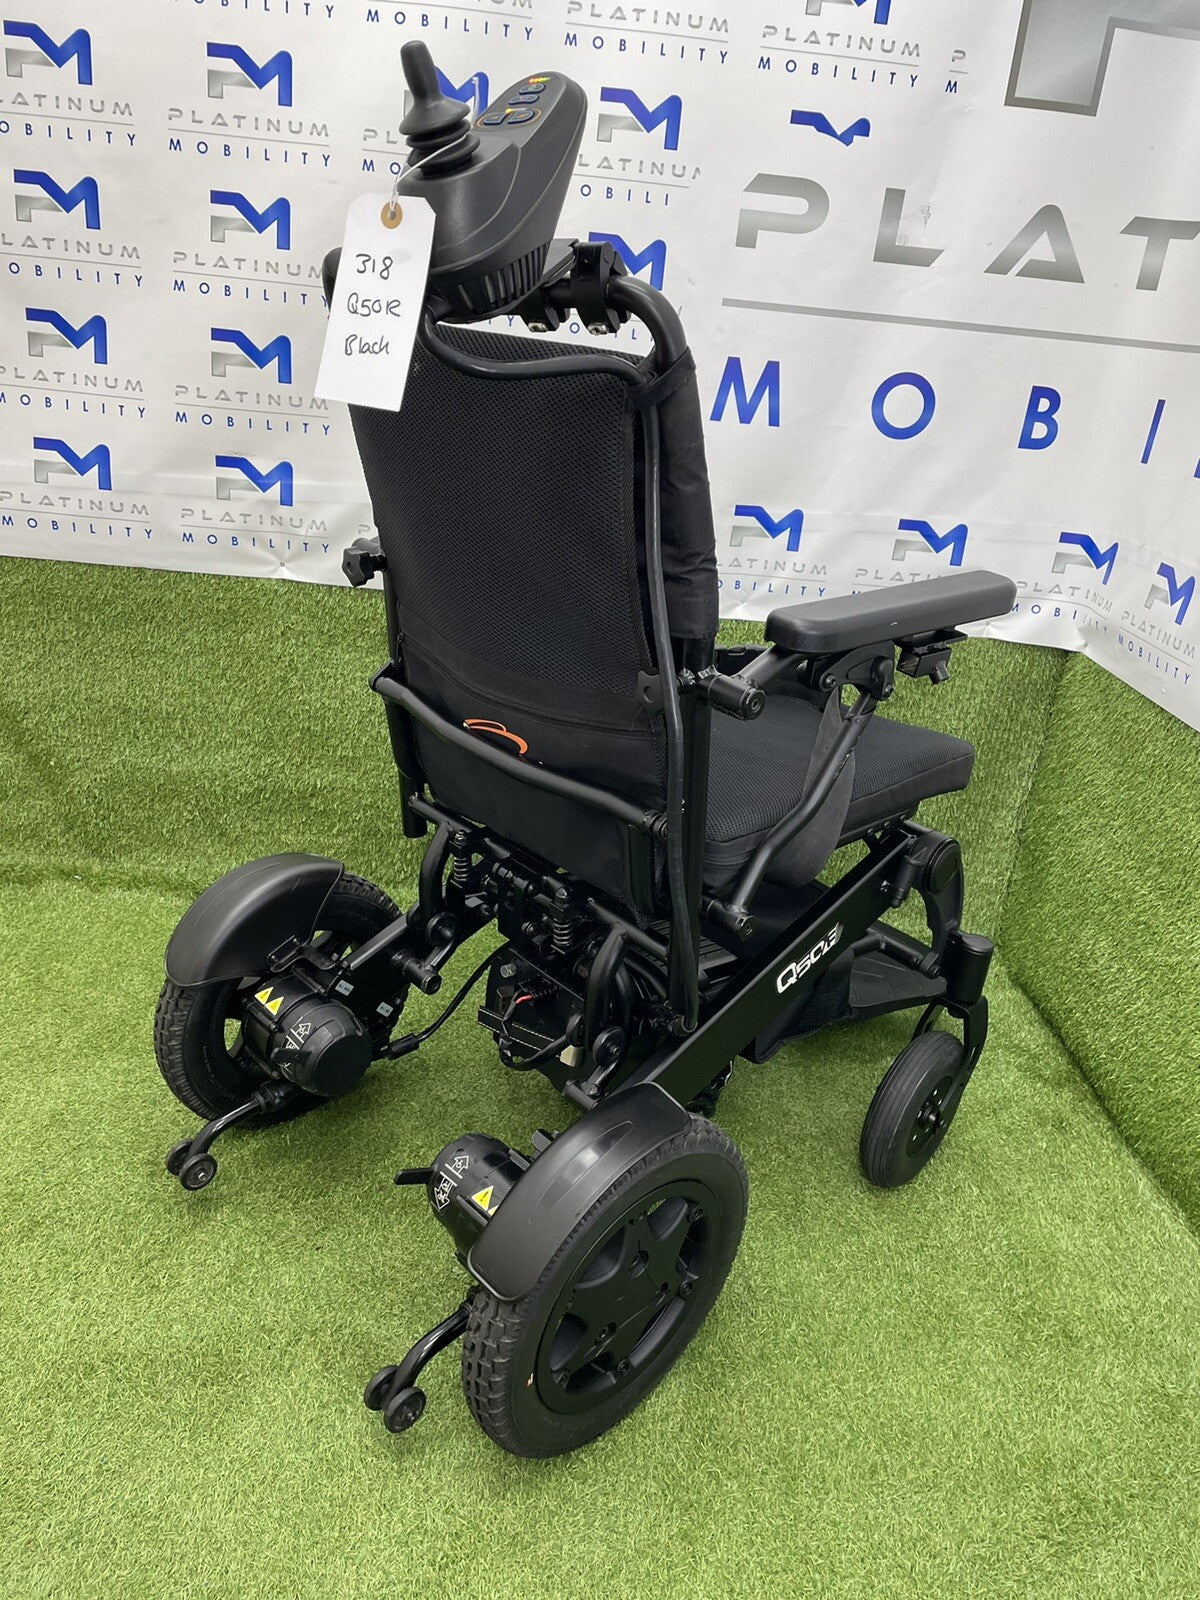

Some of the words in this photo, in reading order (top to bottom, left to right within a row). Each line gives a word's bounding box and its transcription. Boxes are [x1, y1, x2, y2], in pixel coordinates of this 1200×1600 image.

[366, 9, 533, 40] MOBILITY
[567, 0, 729, 33] PLATINUM
[564, 32, 728, 64] MOBILITY
[762, 25, 921, 58] PLATINUM
[758, 56, 918, 88] MOBILITY
[0, 91, 133, 117] ATINUM
[168, 107, 329, 138] PLATINUM
[168, 138, 331, 167] MOBILITY
[356, 253, 394, 281] 318
[346, 292, 402, 318] Q50R
[344, 333, 391, 357] Black
[174, 384, 329, 411] PLATINUM
[174, 411, 331, 436] MOBILITY
[0, 490, 150, 516] PLATINUM
[2, 514, 152, 540] MOBILITY
[181, 507, 328, 532] PLATINUM
[181, 532, 330, 555] MOBILITY
[1121, 610, 1195, 659] PLATINUM
[1118, 634, 1190, 685] MOBILITY
